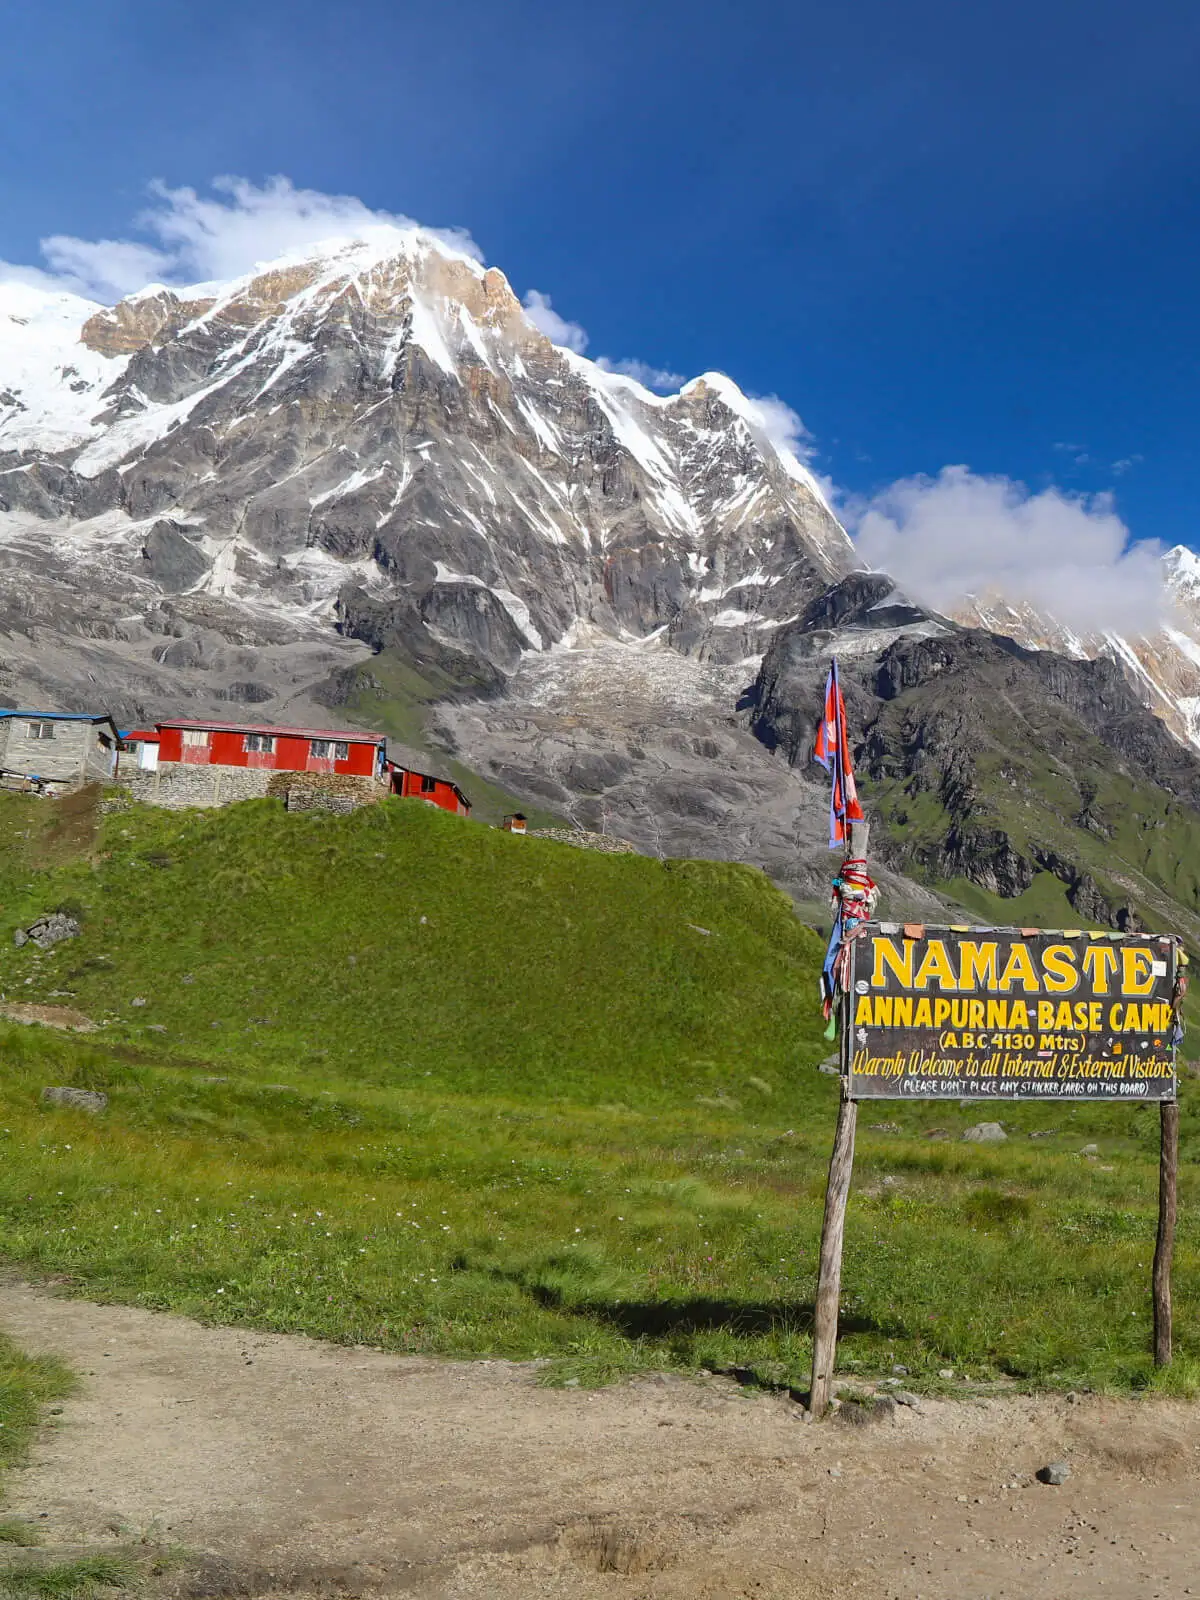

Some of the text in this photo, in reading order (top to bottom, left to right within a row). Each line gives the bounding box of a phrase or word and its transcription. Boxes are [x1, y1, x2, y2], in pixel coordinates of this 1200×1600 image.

[870, 937, 1156, 996] NAMASTE
[855, 996, 1172, 1033] ANNAPURNA BASE CAMP
[1039, 1034, 1086, 1052] Mtrs)
[853, 1048, 906, 1084] Warmly
[908, 1049, 964, 1079] Welcome
[966, 1052, 979, 1077] to
[980, 1053, 1001, 1077] all
[1001, 1053, 1057, 1078] Internal
[1129, 1054, 1175, 1079] Visitors
[1000, 1081, 1019, 1093] ANY
[1099, 1081, 1118, 1094] THIS
